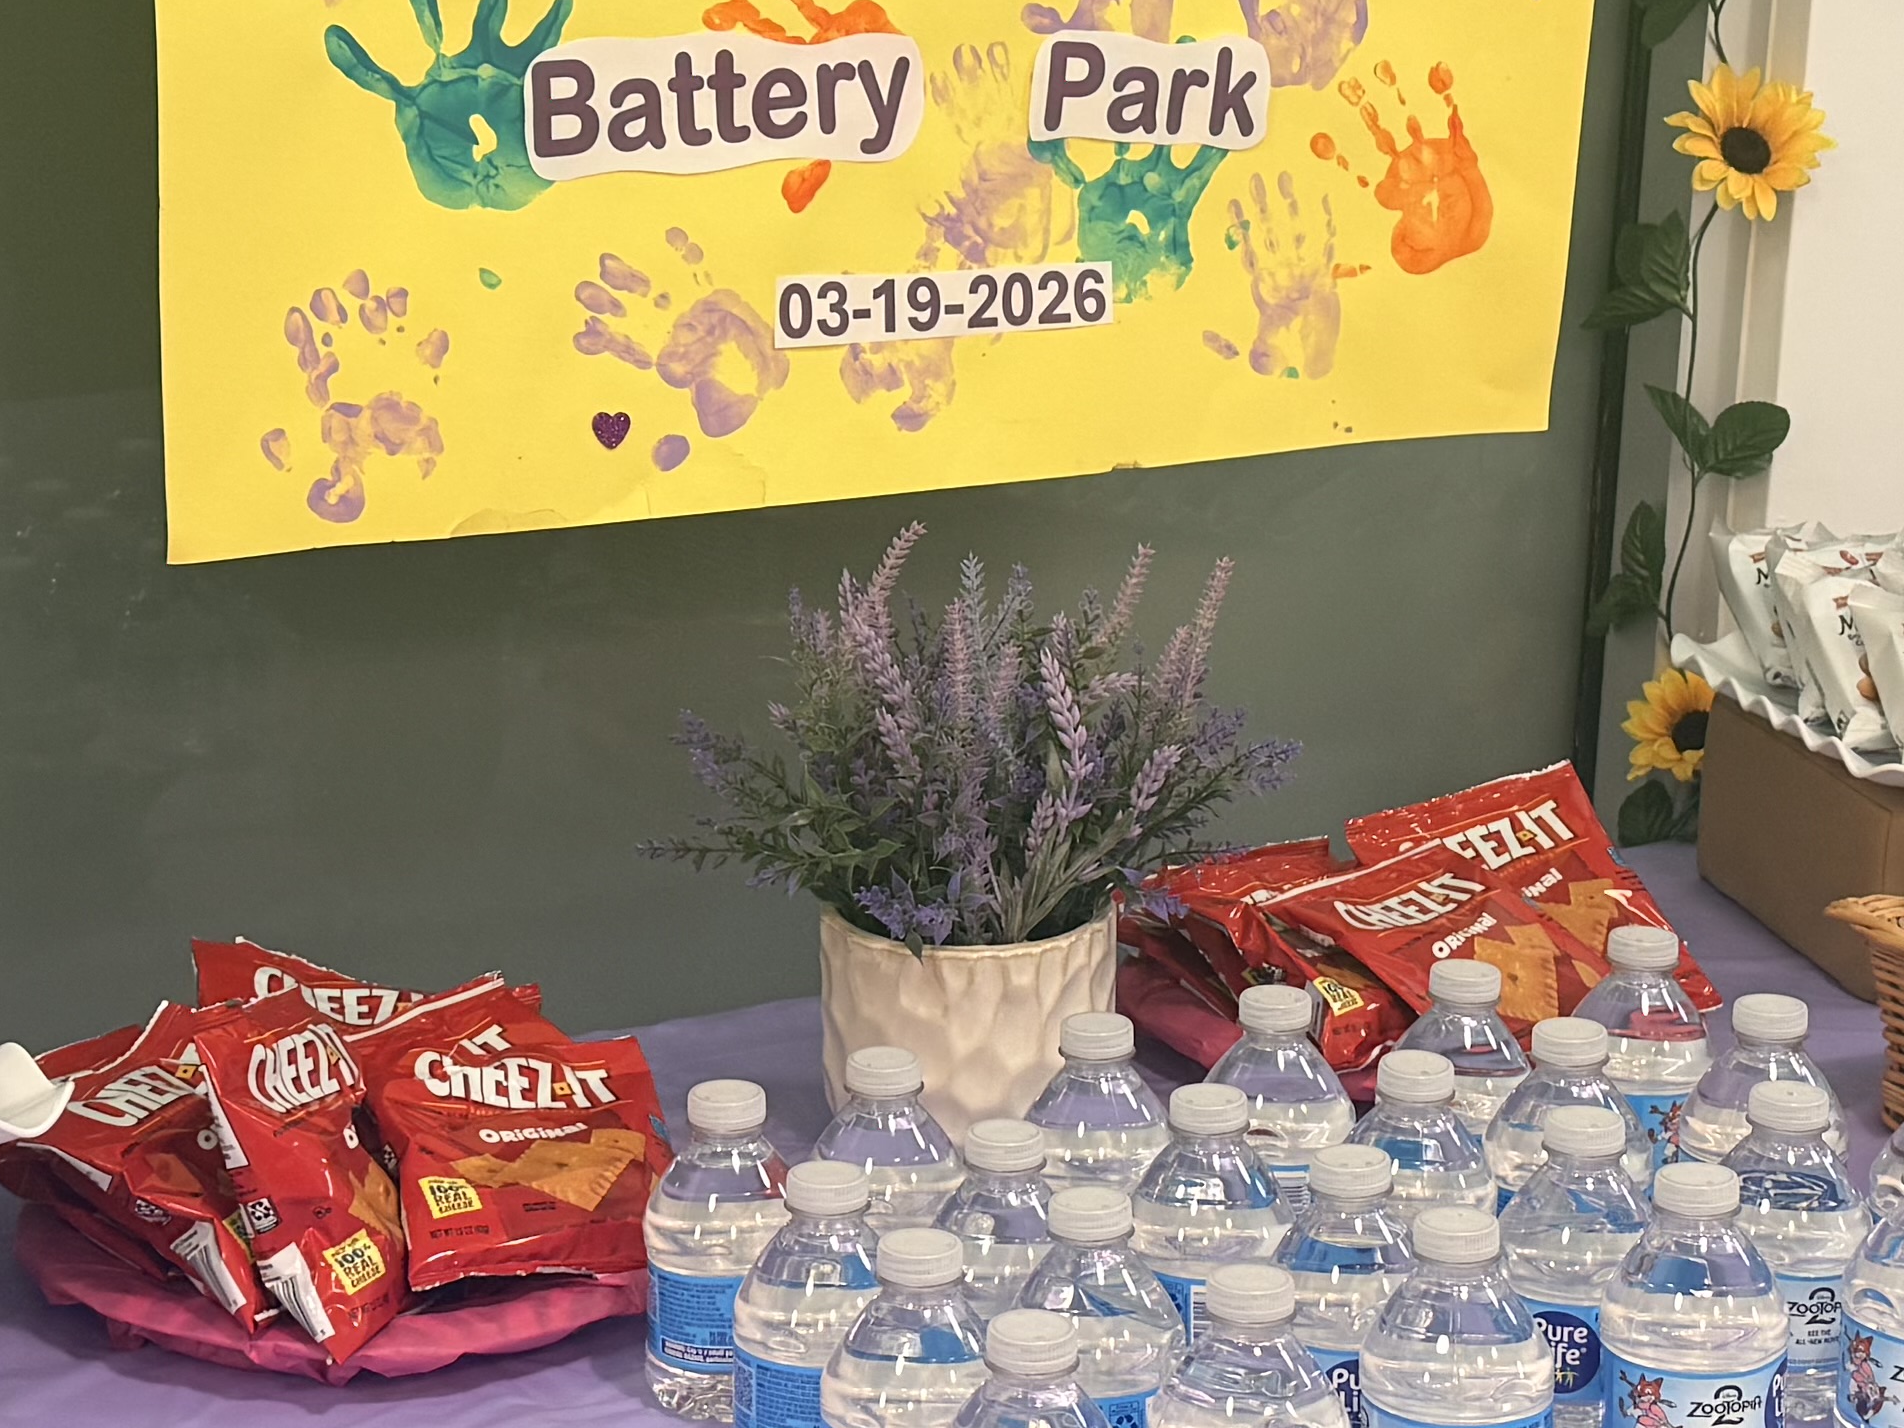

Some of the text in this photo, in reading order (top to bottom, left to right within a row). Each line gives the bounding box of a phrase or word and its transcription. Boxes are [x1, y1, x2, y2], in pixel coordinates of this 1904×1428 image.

[530, 42, 1260, 157] Battery Park
[777, 274, 1108, 341] 03-19-2026
[434, 1192, 470, 1207] REAL
[343, 1256, 378, 1281] REAL
[1687, 1395, 1762, 1418] ZOOTOPIA
